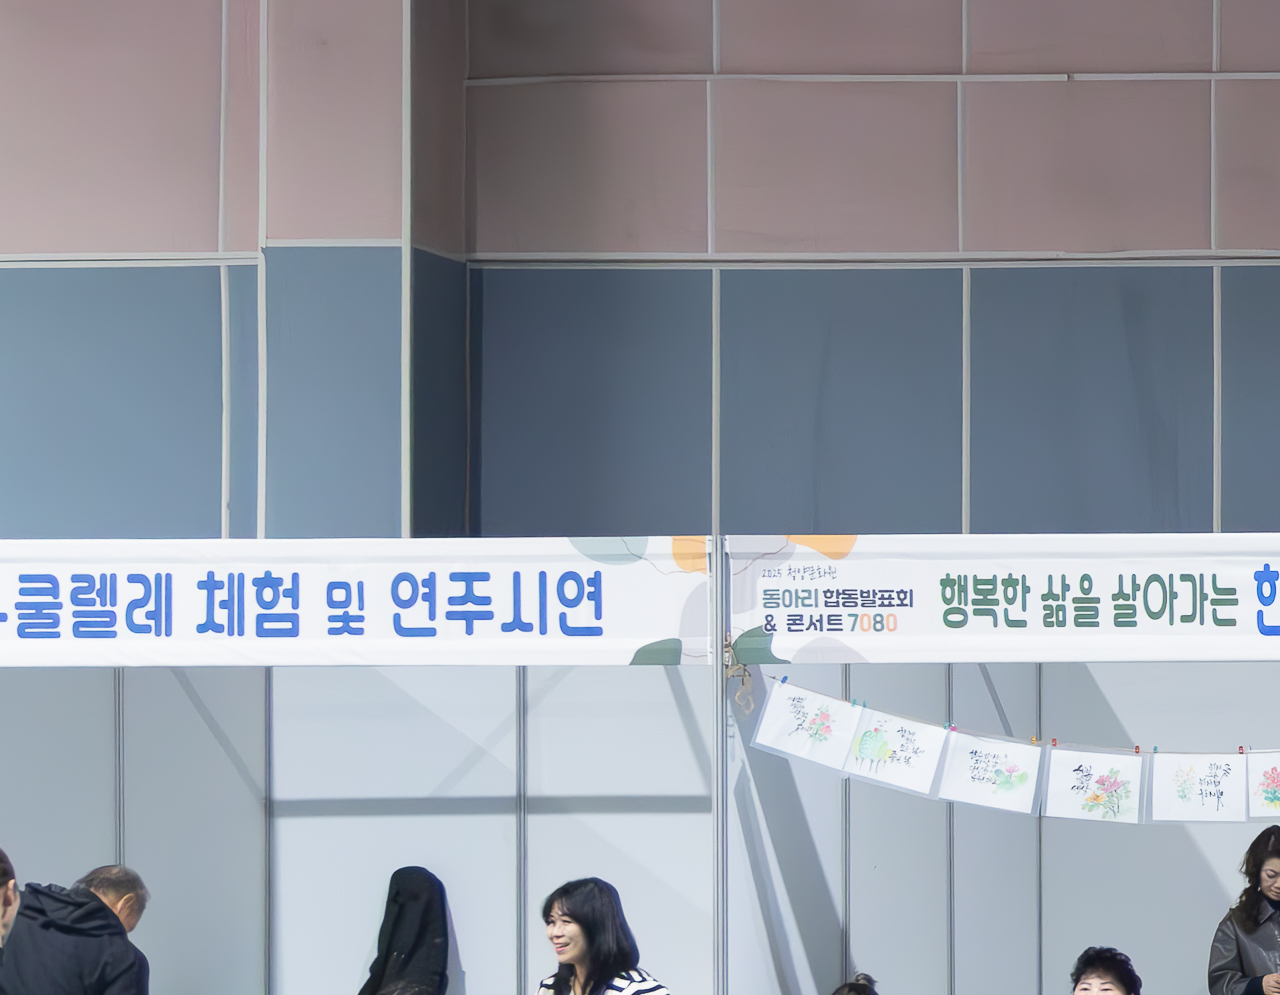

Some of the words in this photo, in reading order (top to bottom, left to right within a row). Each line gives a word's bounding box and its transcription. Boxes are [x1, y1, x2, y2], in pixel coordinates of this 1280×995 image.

[762, 569, 782, 578] 2025
[788, 565, 837, 581] 청양문화원
[0, 573, 172, 639] 쿨렐레
[196, 570, 300, 638] 체험
[326, 581, 365, 636] 및
[391, 570, 603, 638] 연주시연
[763, 588, 818, 608] 동아리
[823, 589, 913, 608] 합동발표회
[940, 573, 1030, 628] 행복한
[1041, 574, 1100, 628] 삶을
[1112, 573, 1239, 628] 살아가는
[764, 614, 777, 632] &
[786, 614, 843, 632] 콘서트
[848, 613, 897, 632] 7080
